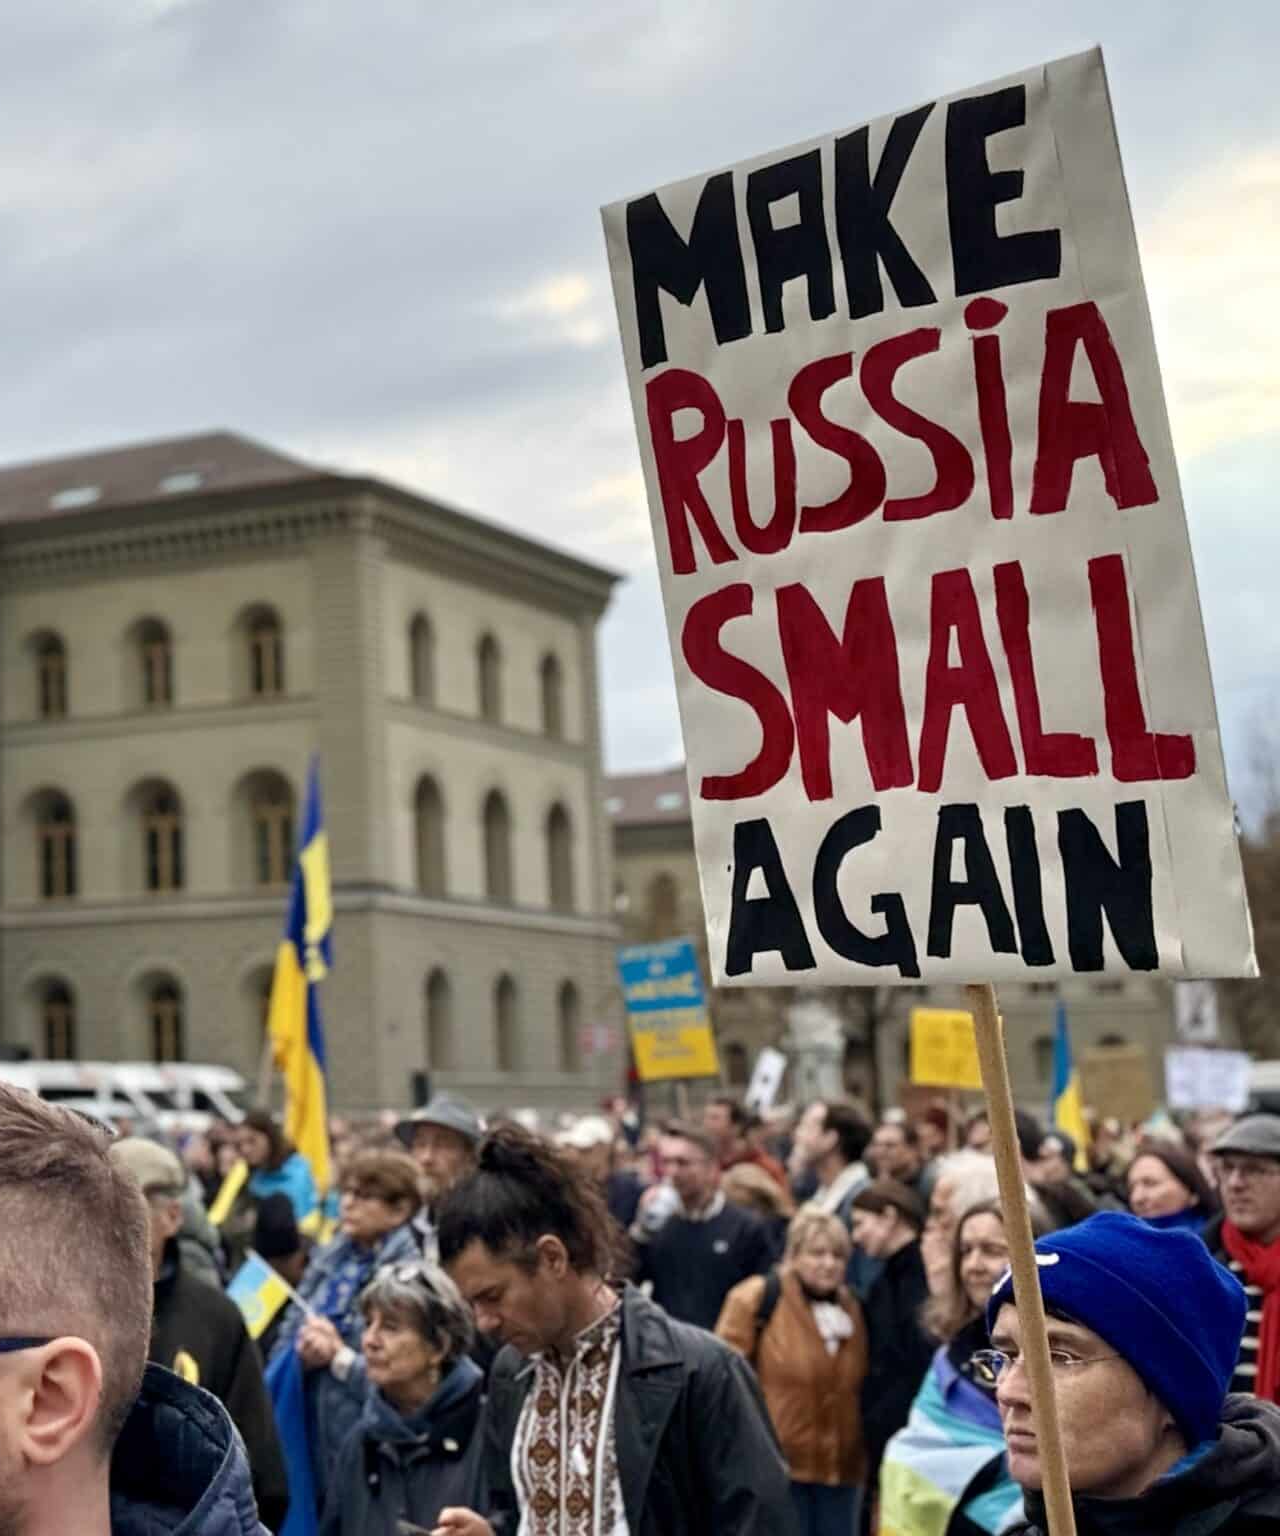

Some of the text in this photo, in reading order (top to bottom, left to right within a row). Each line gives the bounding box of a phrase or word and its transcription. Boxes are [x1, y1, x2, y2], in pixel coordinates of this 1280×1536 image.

[626, 84, 1062, 370] MAKE
[681, 553, 1196, 802] SMALL
[725, 801, 1159, 977] AGAIN
